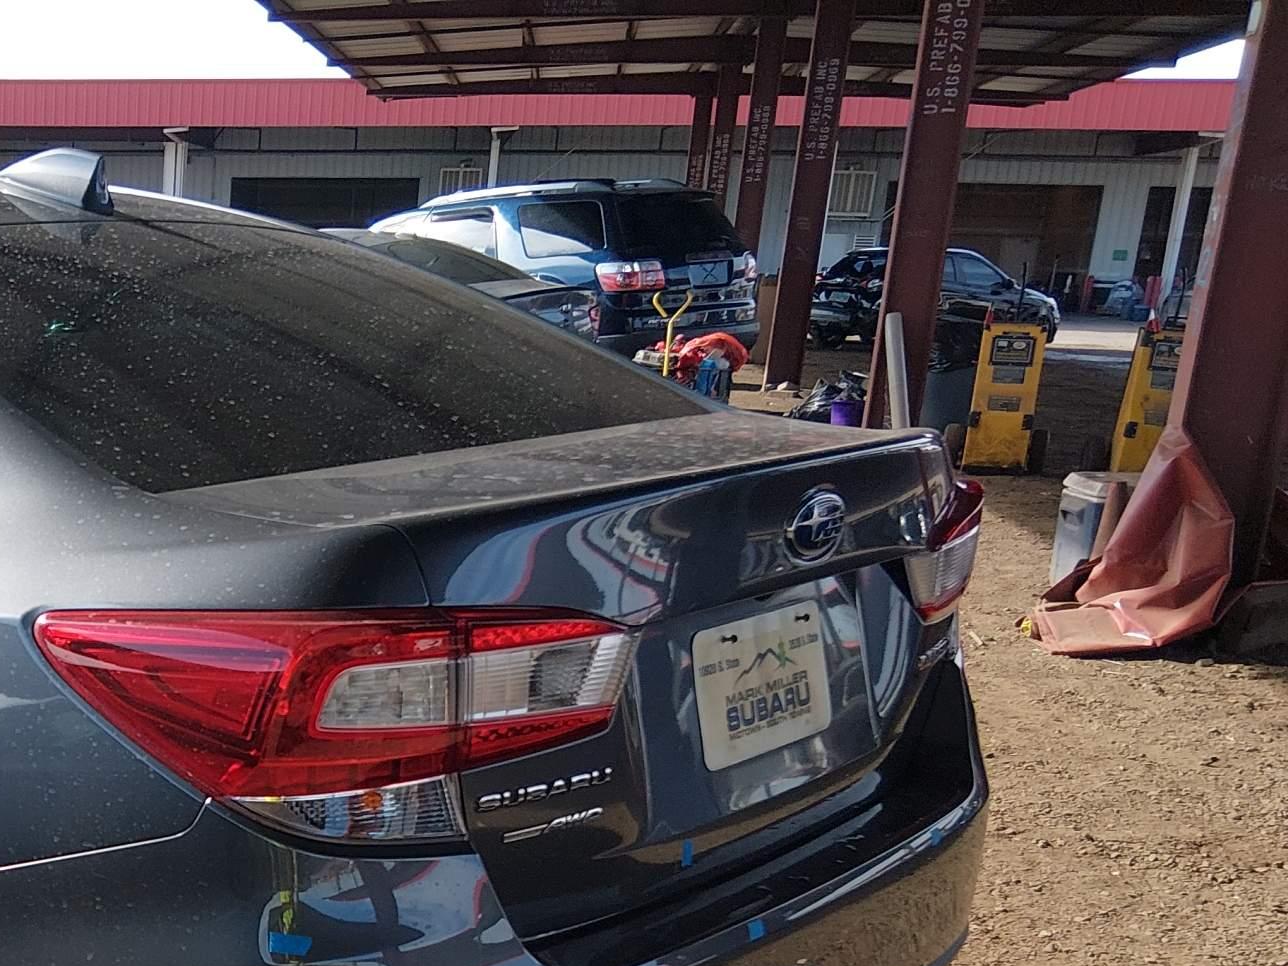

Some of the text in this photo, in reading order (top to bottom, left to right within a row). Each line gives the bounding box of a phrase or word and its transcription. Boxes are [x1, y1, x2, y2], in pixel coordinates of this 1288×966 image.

[923, 2, 953, 115] U.S. PREFAB
[809, 85, 825, 132] PREFAB
[725, 670, 809, 707] MARK MILLER
[726, 681, 811, 732] SUBARU
[477, 766, 613, 812] SUBARU
